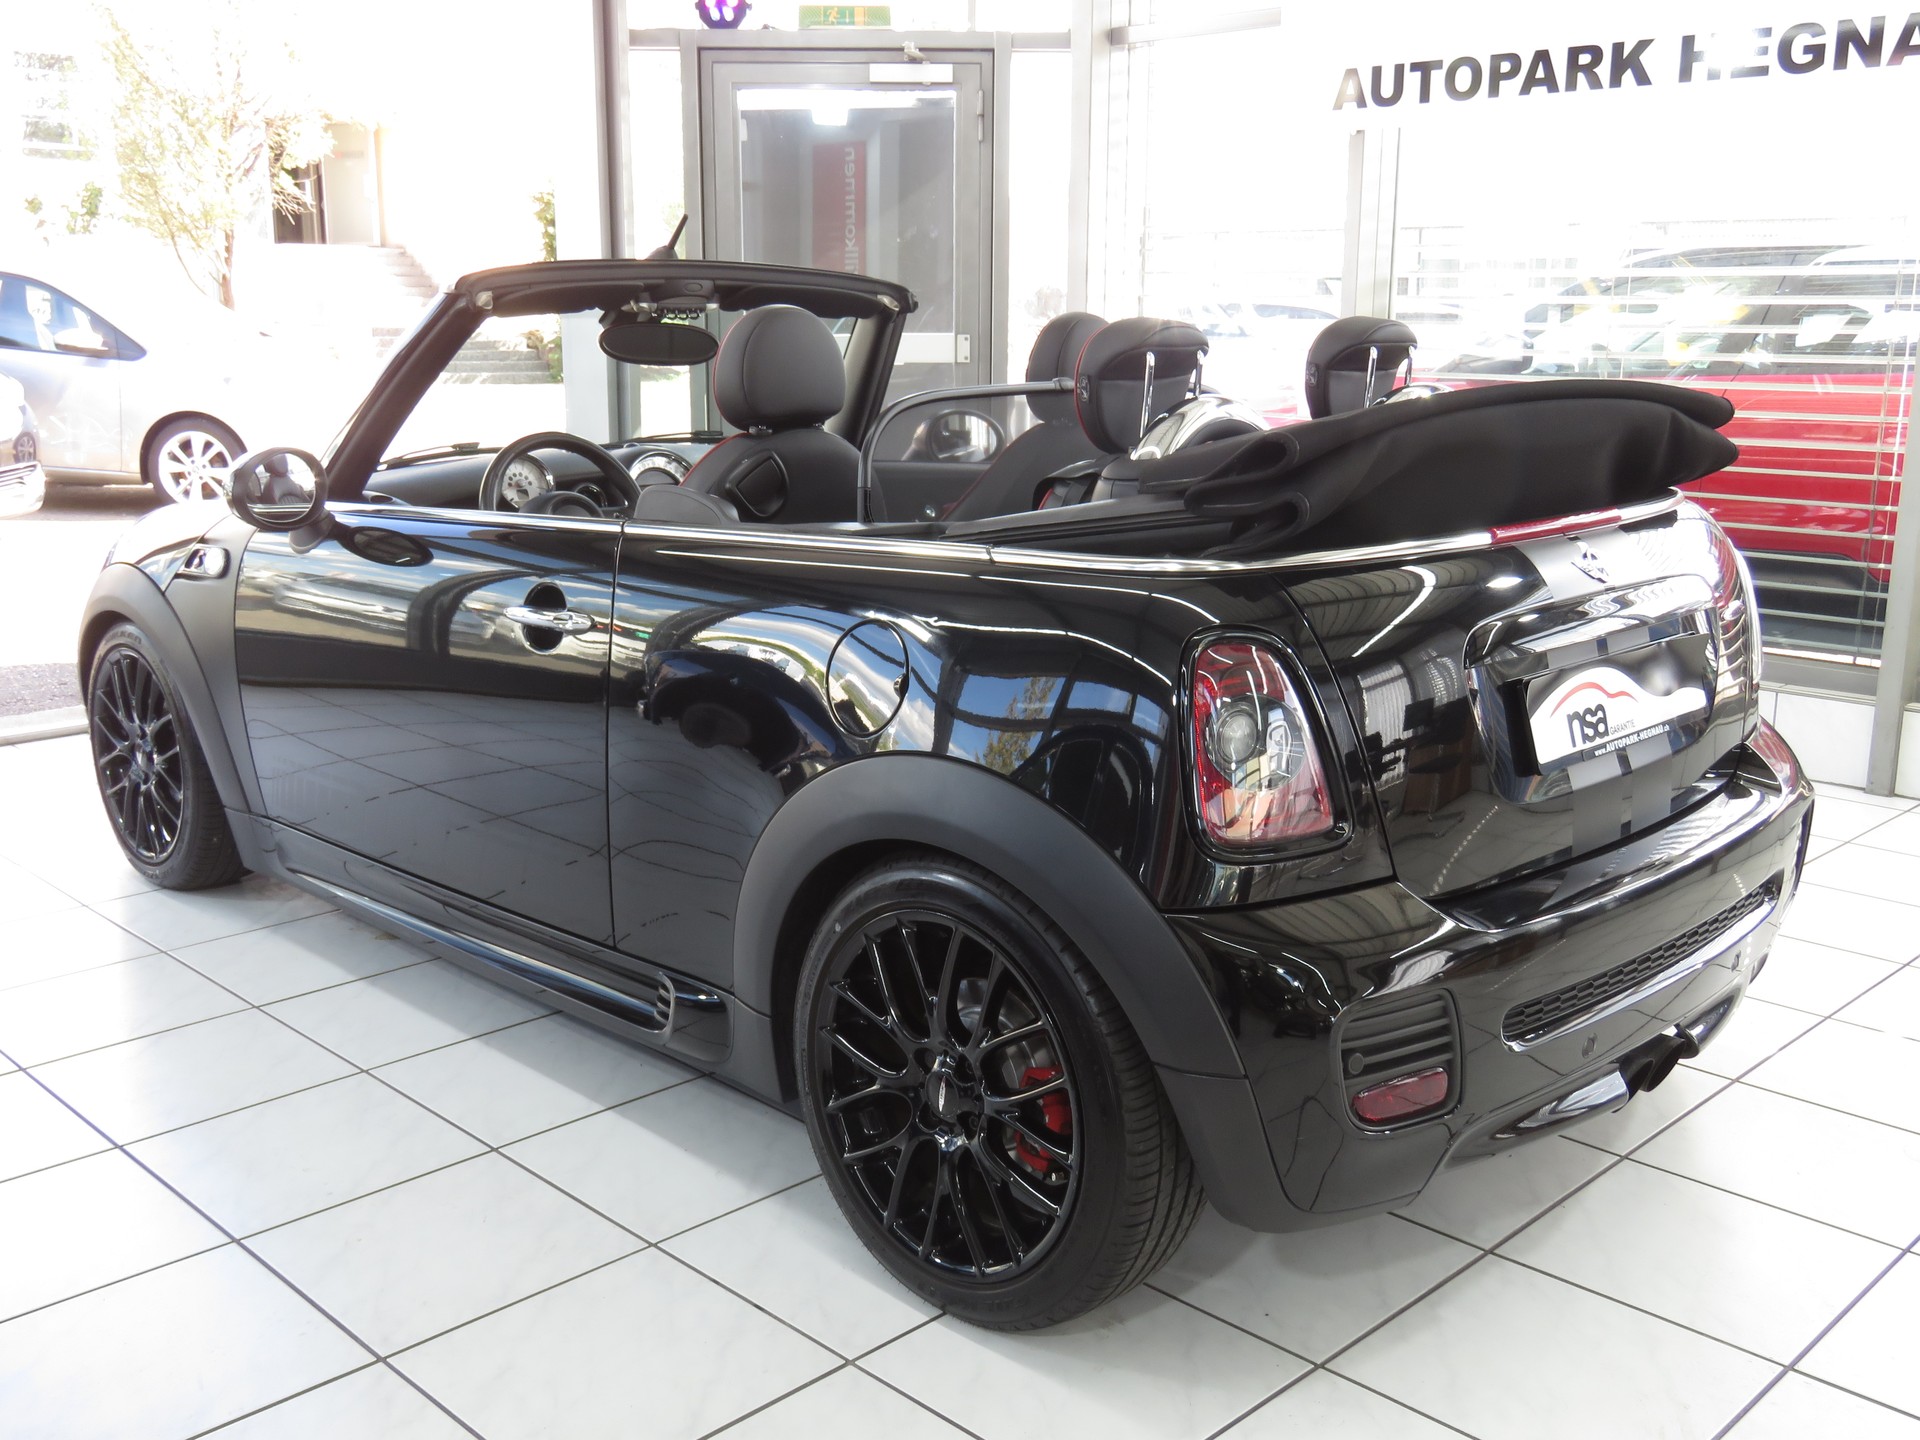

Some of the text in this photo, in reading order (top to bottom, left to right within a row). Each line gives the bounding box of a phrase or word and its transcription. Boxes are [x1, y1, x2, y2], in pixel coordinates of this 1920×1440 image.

[1332, 38, 1656, 111] AUTOPARK
[1567, 703, 1610, 748] nsa
[1610, 719, 1636, 736] GARANTIE
